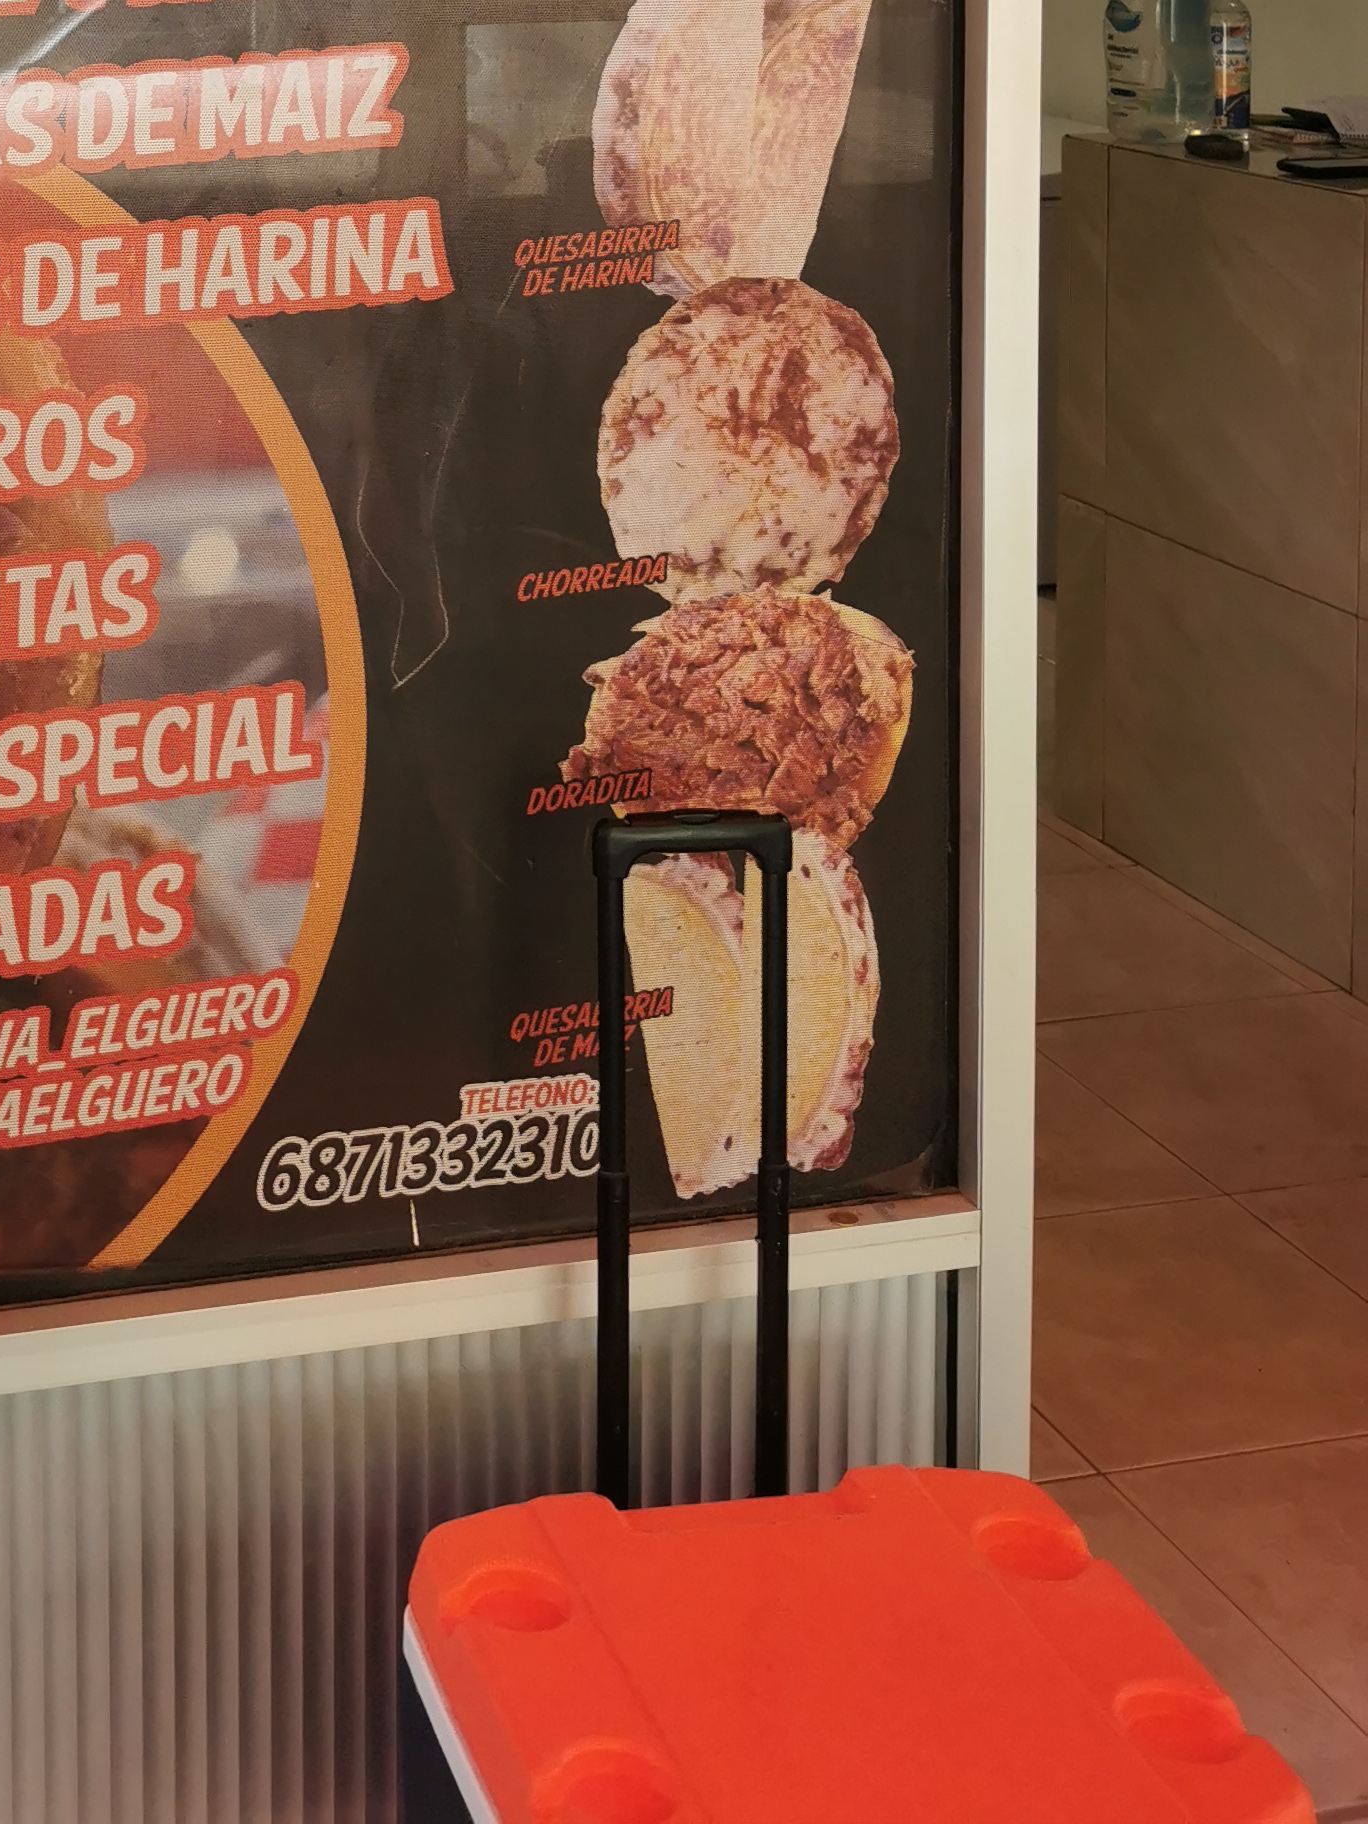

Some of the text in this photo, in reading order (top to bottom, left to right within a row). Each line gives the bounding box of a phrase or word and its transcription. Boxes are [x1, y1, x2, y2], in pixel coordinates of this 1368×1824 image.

[77, 72, 177, 162] DE
[198, 53, 398, 151] MAIZ
[22, 237, 122, 326] DE
[144, 209, 441, 316] HARINA
[514, 221, 679, 267] QUESABIRRIA
[522, 254, 654, 297] DE HARINA
[517, 554, 667, 602] CHORREADA
[526, 770, 652, 816] DORADITA
[509, 987, 674, 1043] QUESARRIA
[533, 1036, 570, 1068] DE
[465, 1077, 597, 1115] TELEFONO:
[261, 1107, 601, 1208] 6871332310
